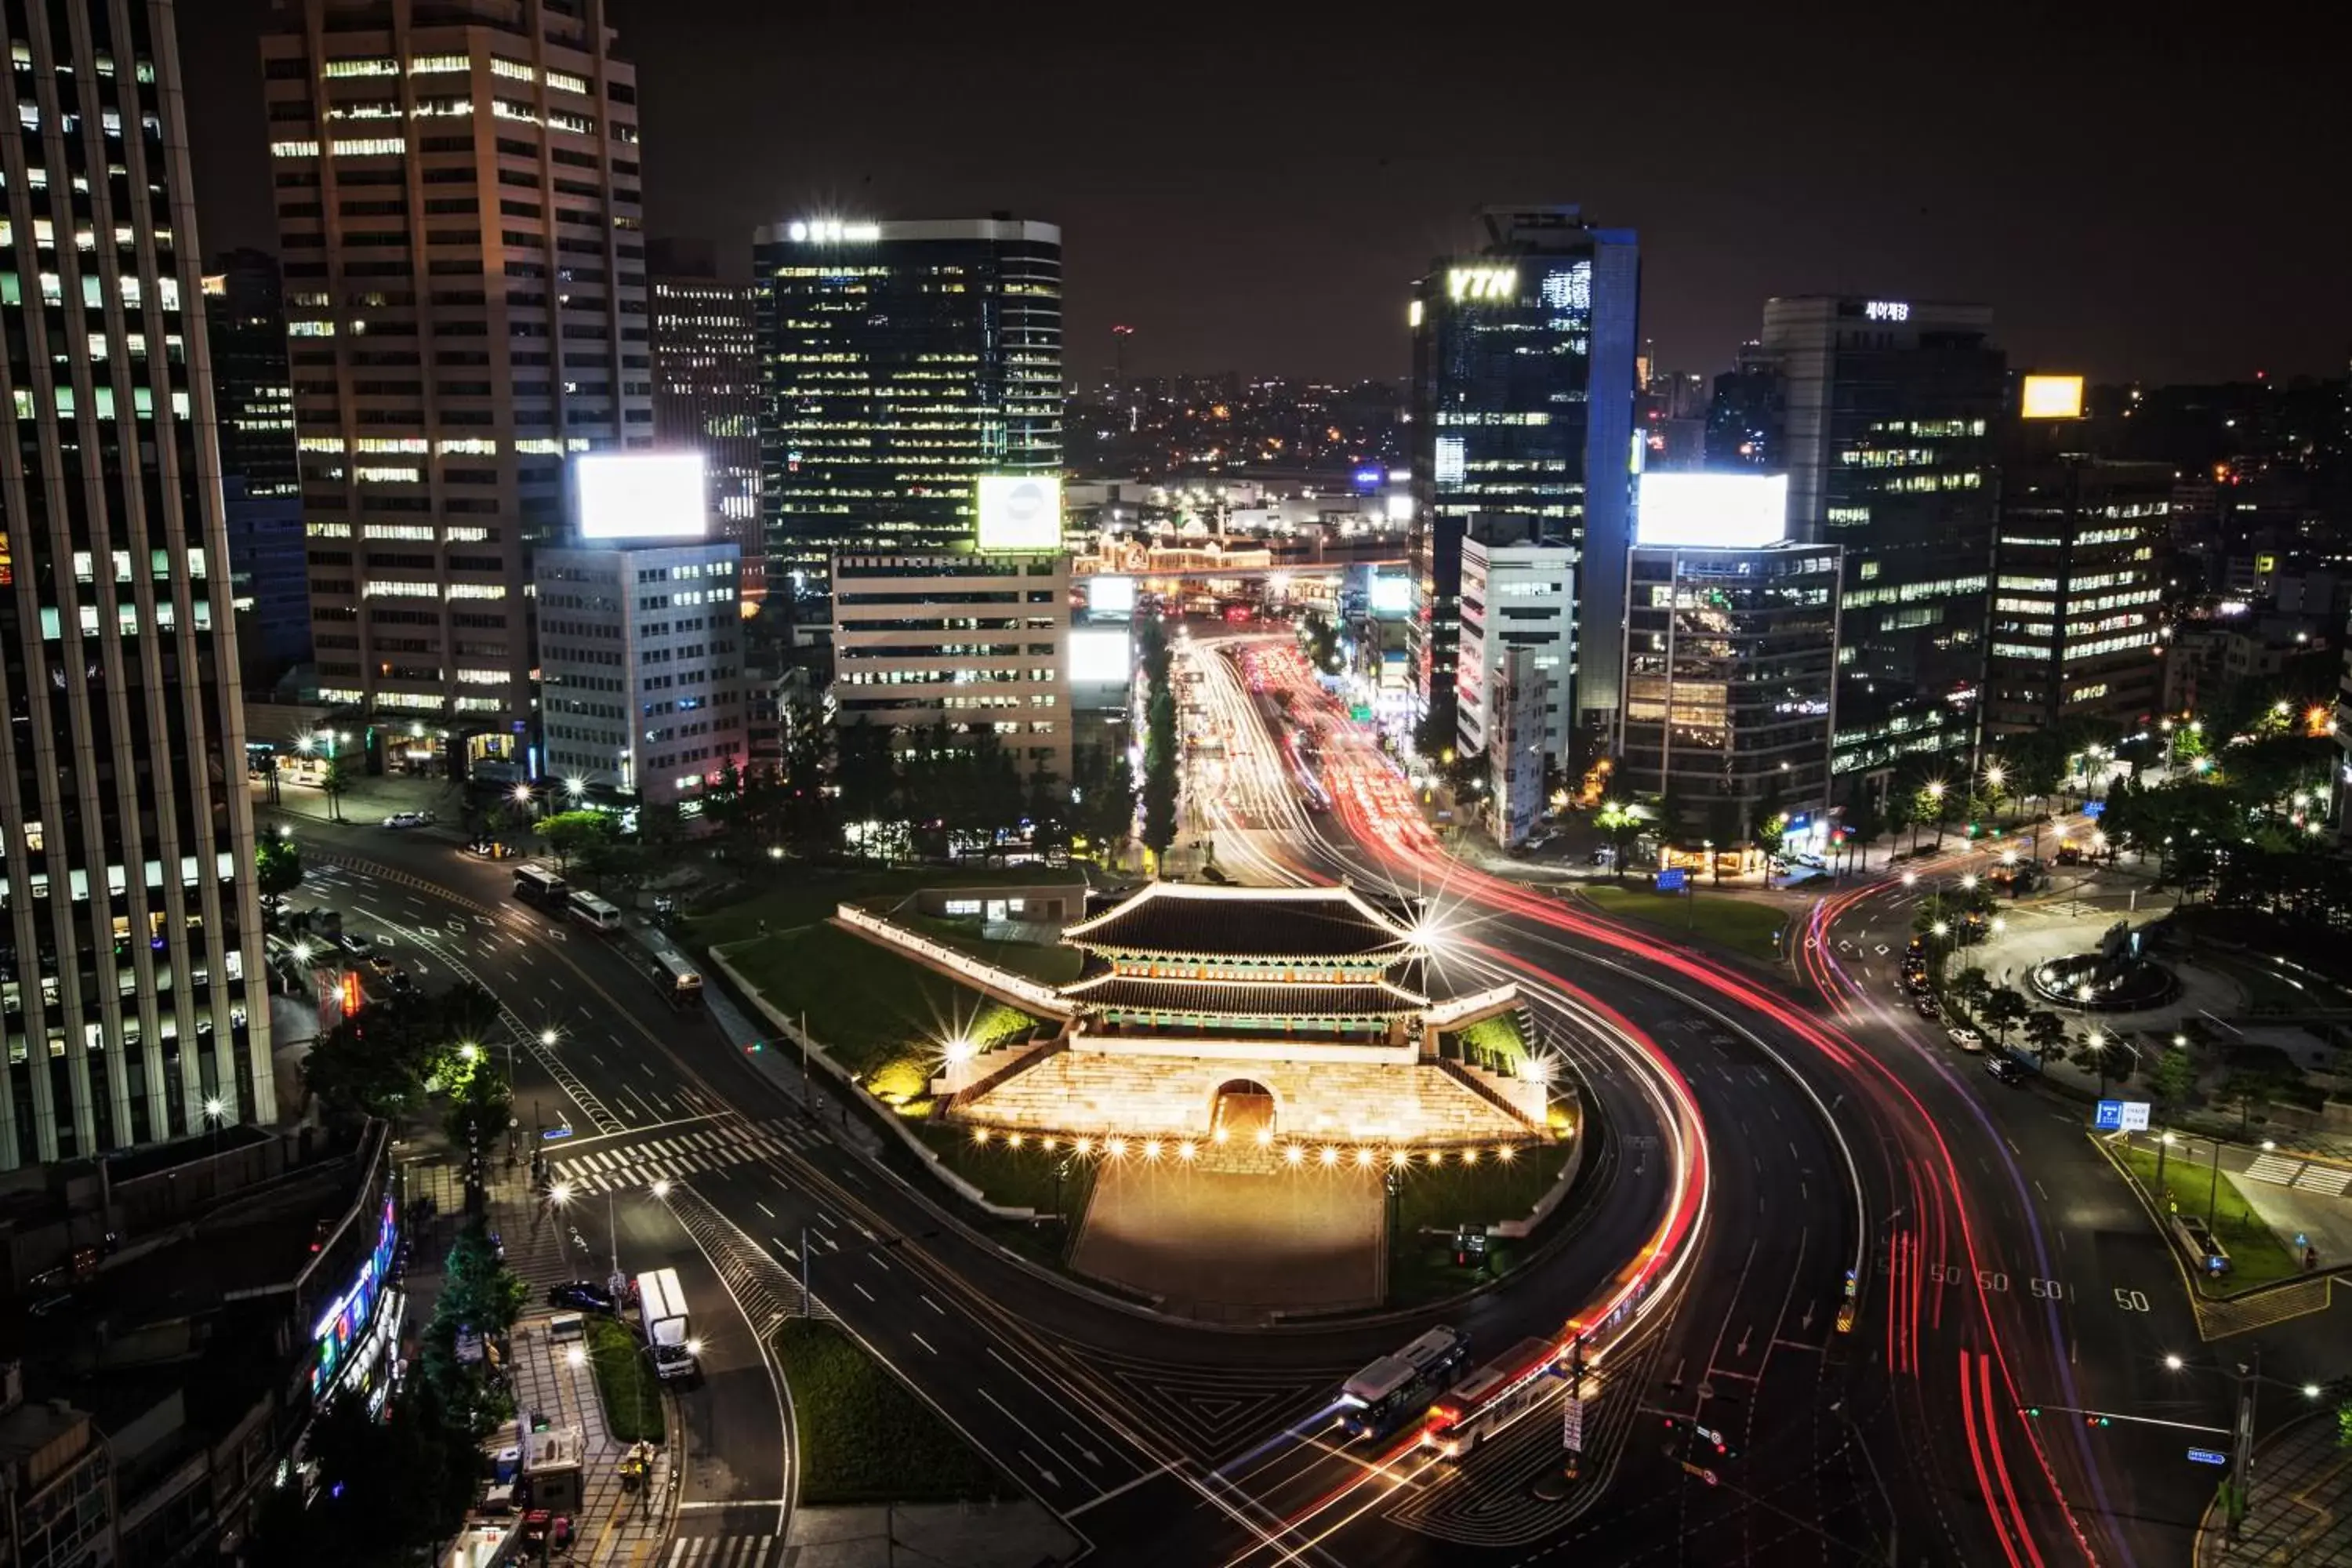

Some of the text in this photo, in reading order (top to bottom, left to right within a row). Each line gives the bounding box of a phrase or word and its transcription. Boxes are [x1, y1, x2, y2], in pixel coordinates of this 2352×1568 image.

[1447, 267, 1518, 298] YTN
[1930, 1263, 1961, 1285] 50
[1978, 1270, 2009, 1292] 50
[2031, 1277, 2063, 1300] 50
[2114, 1288, 2150, 1312] 50
